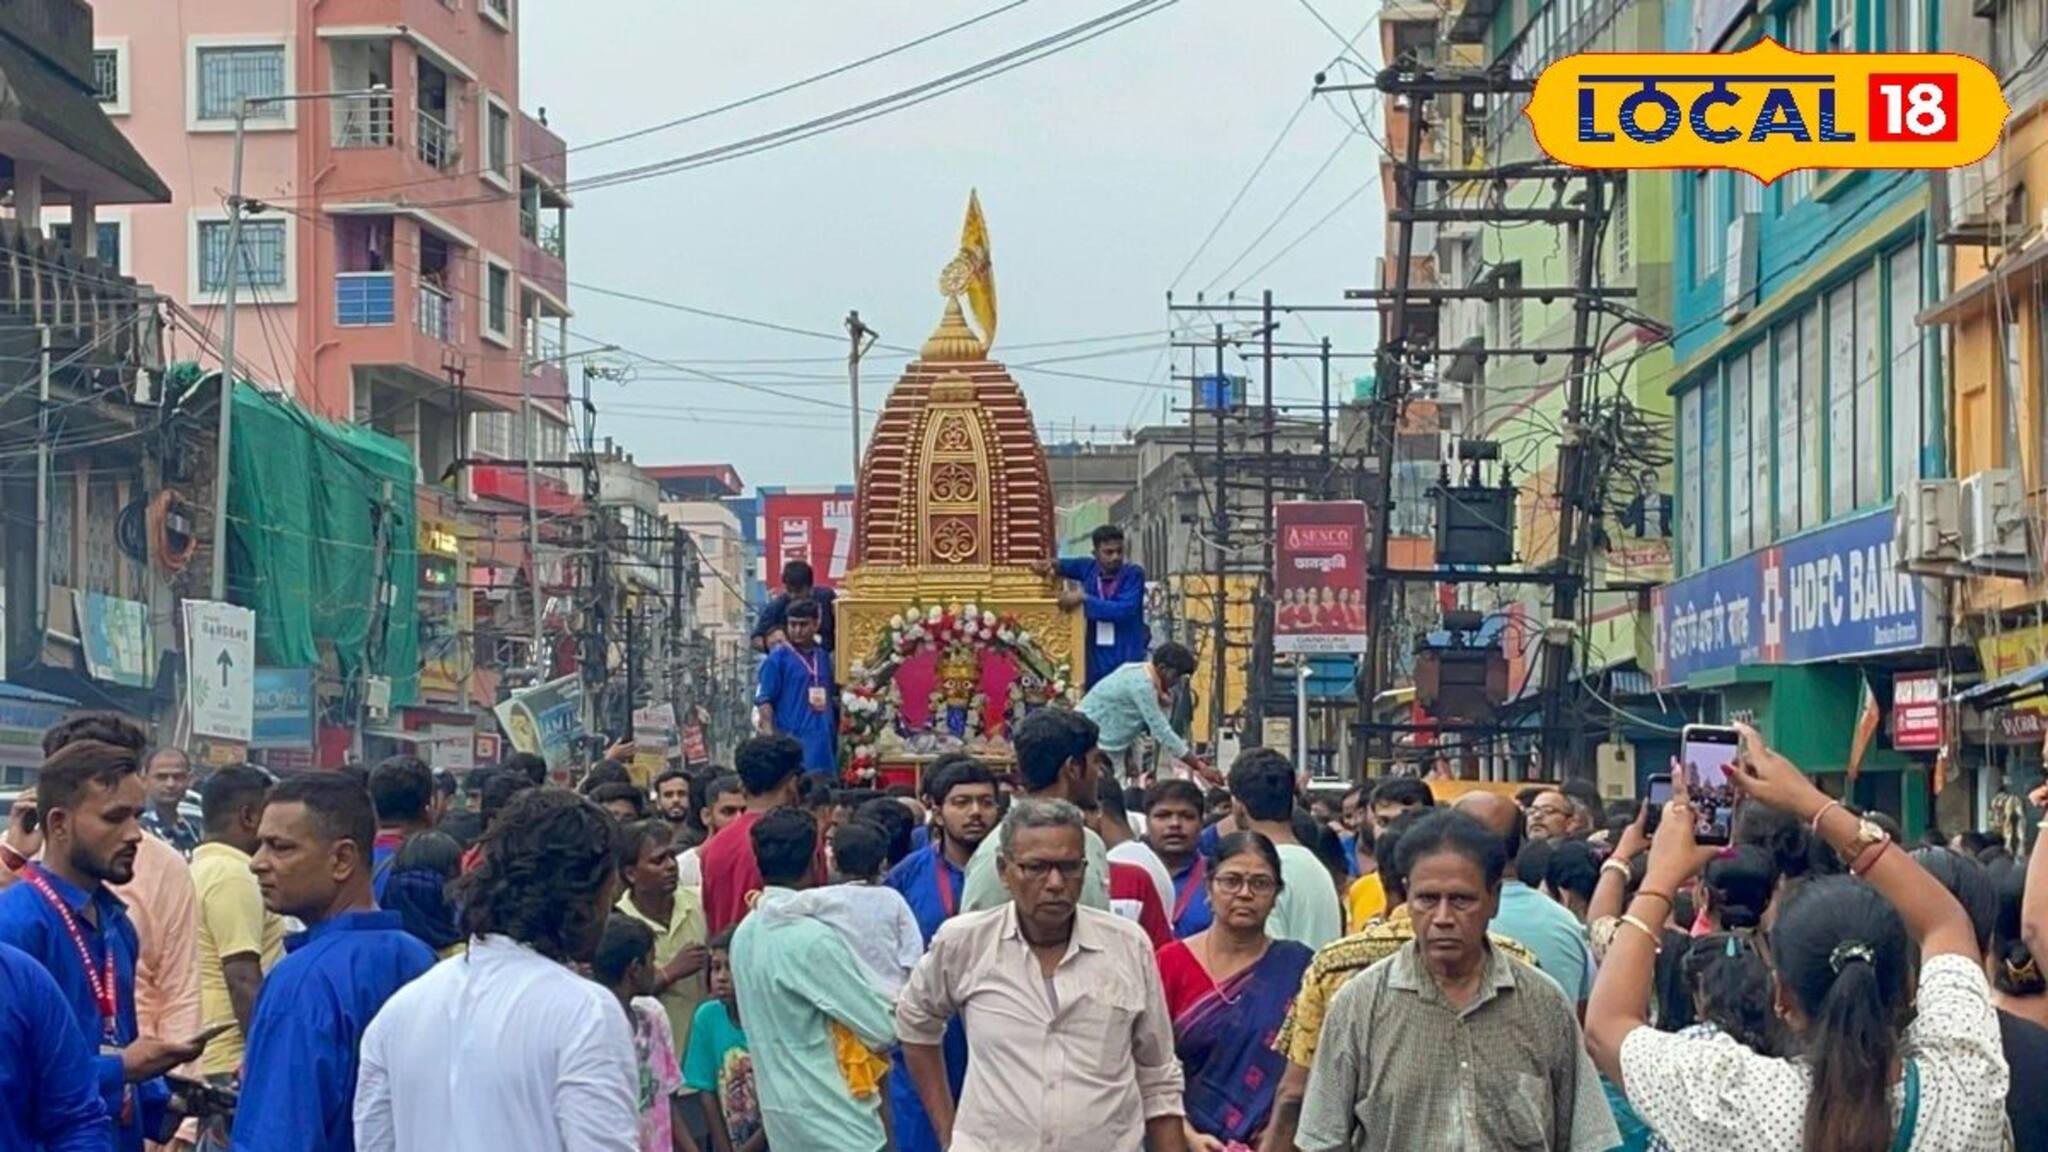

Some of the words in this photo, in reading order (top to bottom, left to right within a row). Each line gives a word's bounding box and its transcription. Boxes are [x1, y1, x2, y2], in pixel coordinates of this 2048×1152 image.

[822, 500, 854, 515] FLAT
[780, 516, 812, 573] ALE
[1301, 529, 1349, 542] SENCO
[1790, 552, 1843, 633] HDFC
[1849, 540, 1916, 622] BANK
